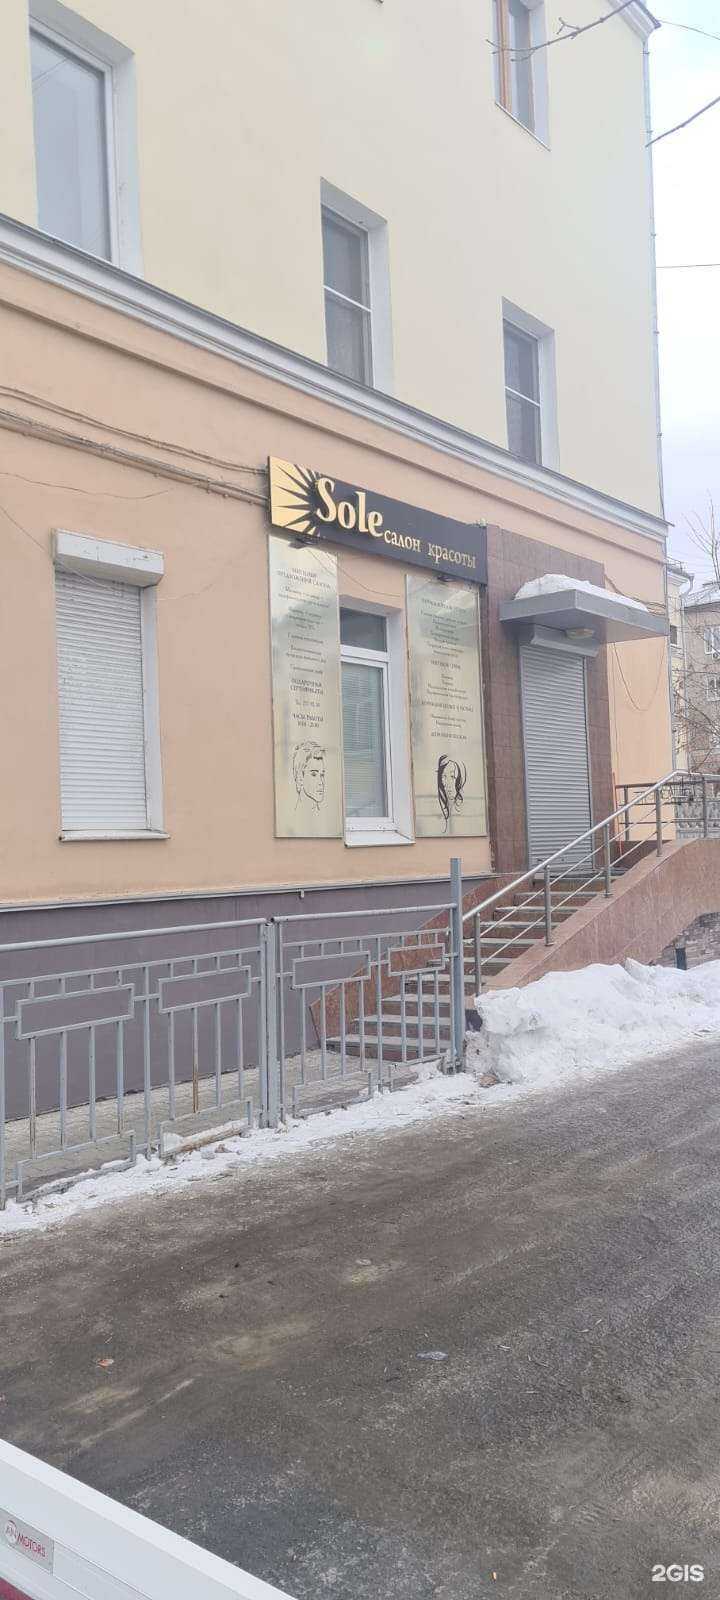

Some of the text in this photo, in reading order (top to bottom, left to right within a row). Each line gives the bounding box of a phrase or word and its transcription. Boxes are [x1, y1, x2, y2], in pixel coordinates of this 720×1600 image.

[316, 477, 384, 538] Sole
[384, 529, 476, 569] салон красоты
